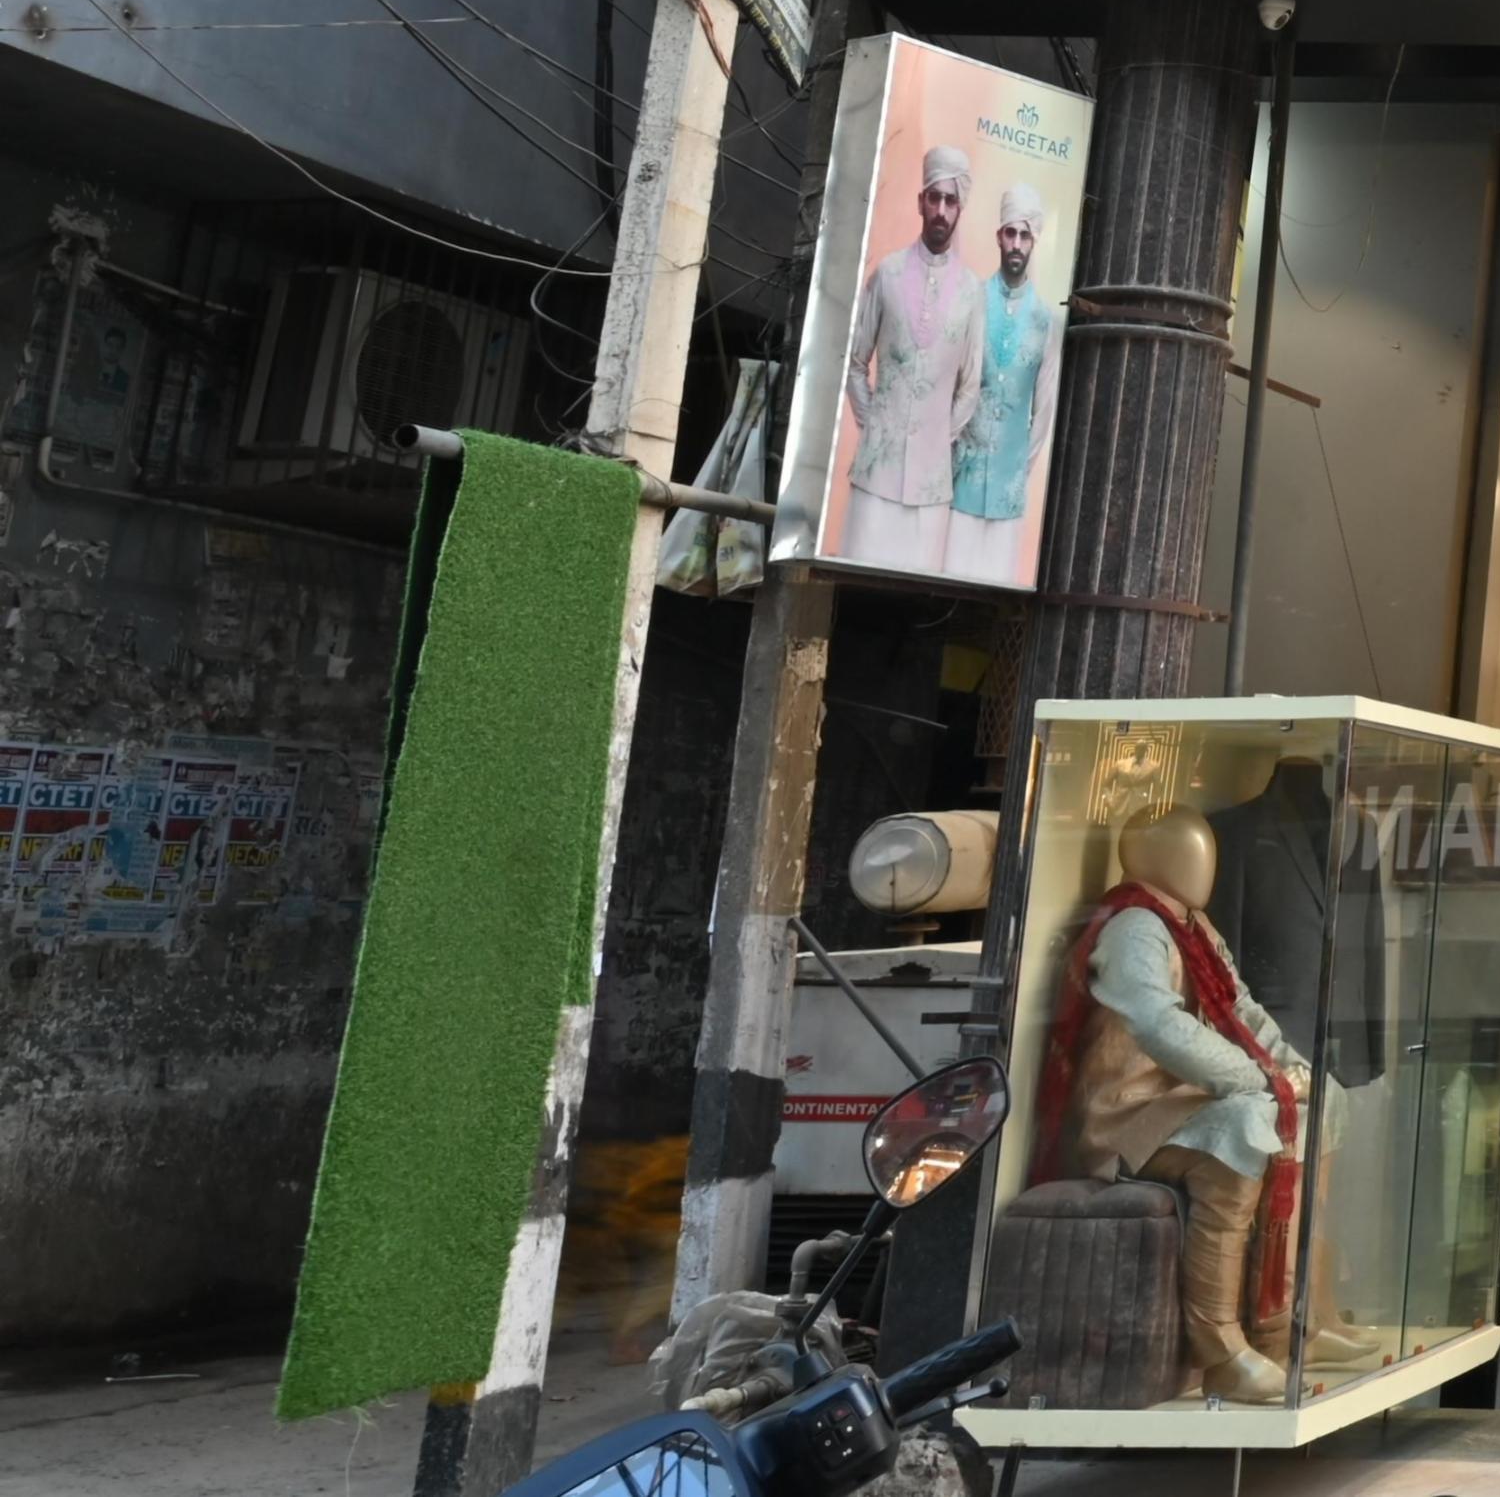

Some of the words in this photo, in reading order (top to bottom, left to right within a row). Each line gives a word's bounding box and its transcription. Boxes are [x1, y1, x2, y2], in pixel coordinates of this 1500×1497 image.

[976, 116, 1069, 160] MANGETAR
[29, 783, 94, 808] CTET
[783, 1101, 884, 1116] ONTINENTA
